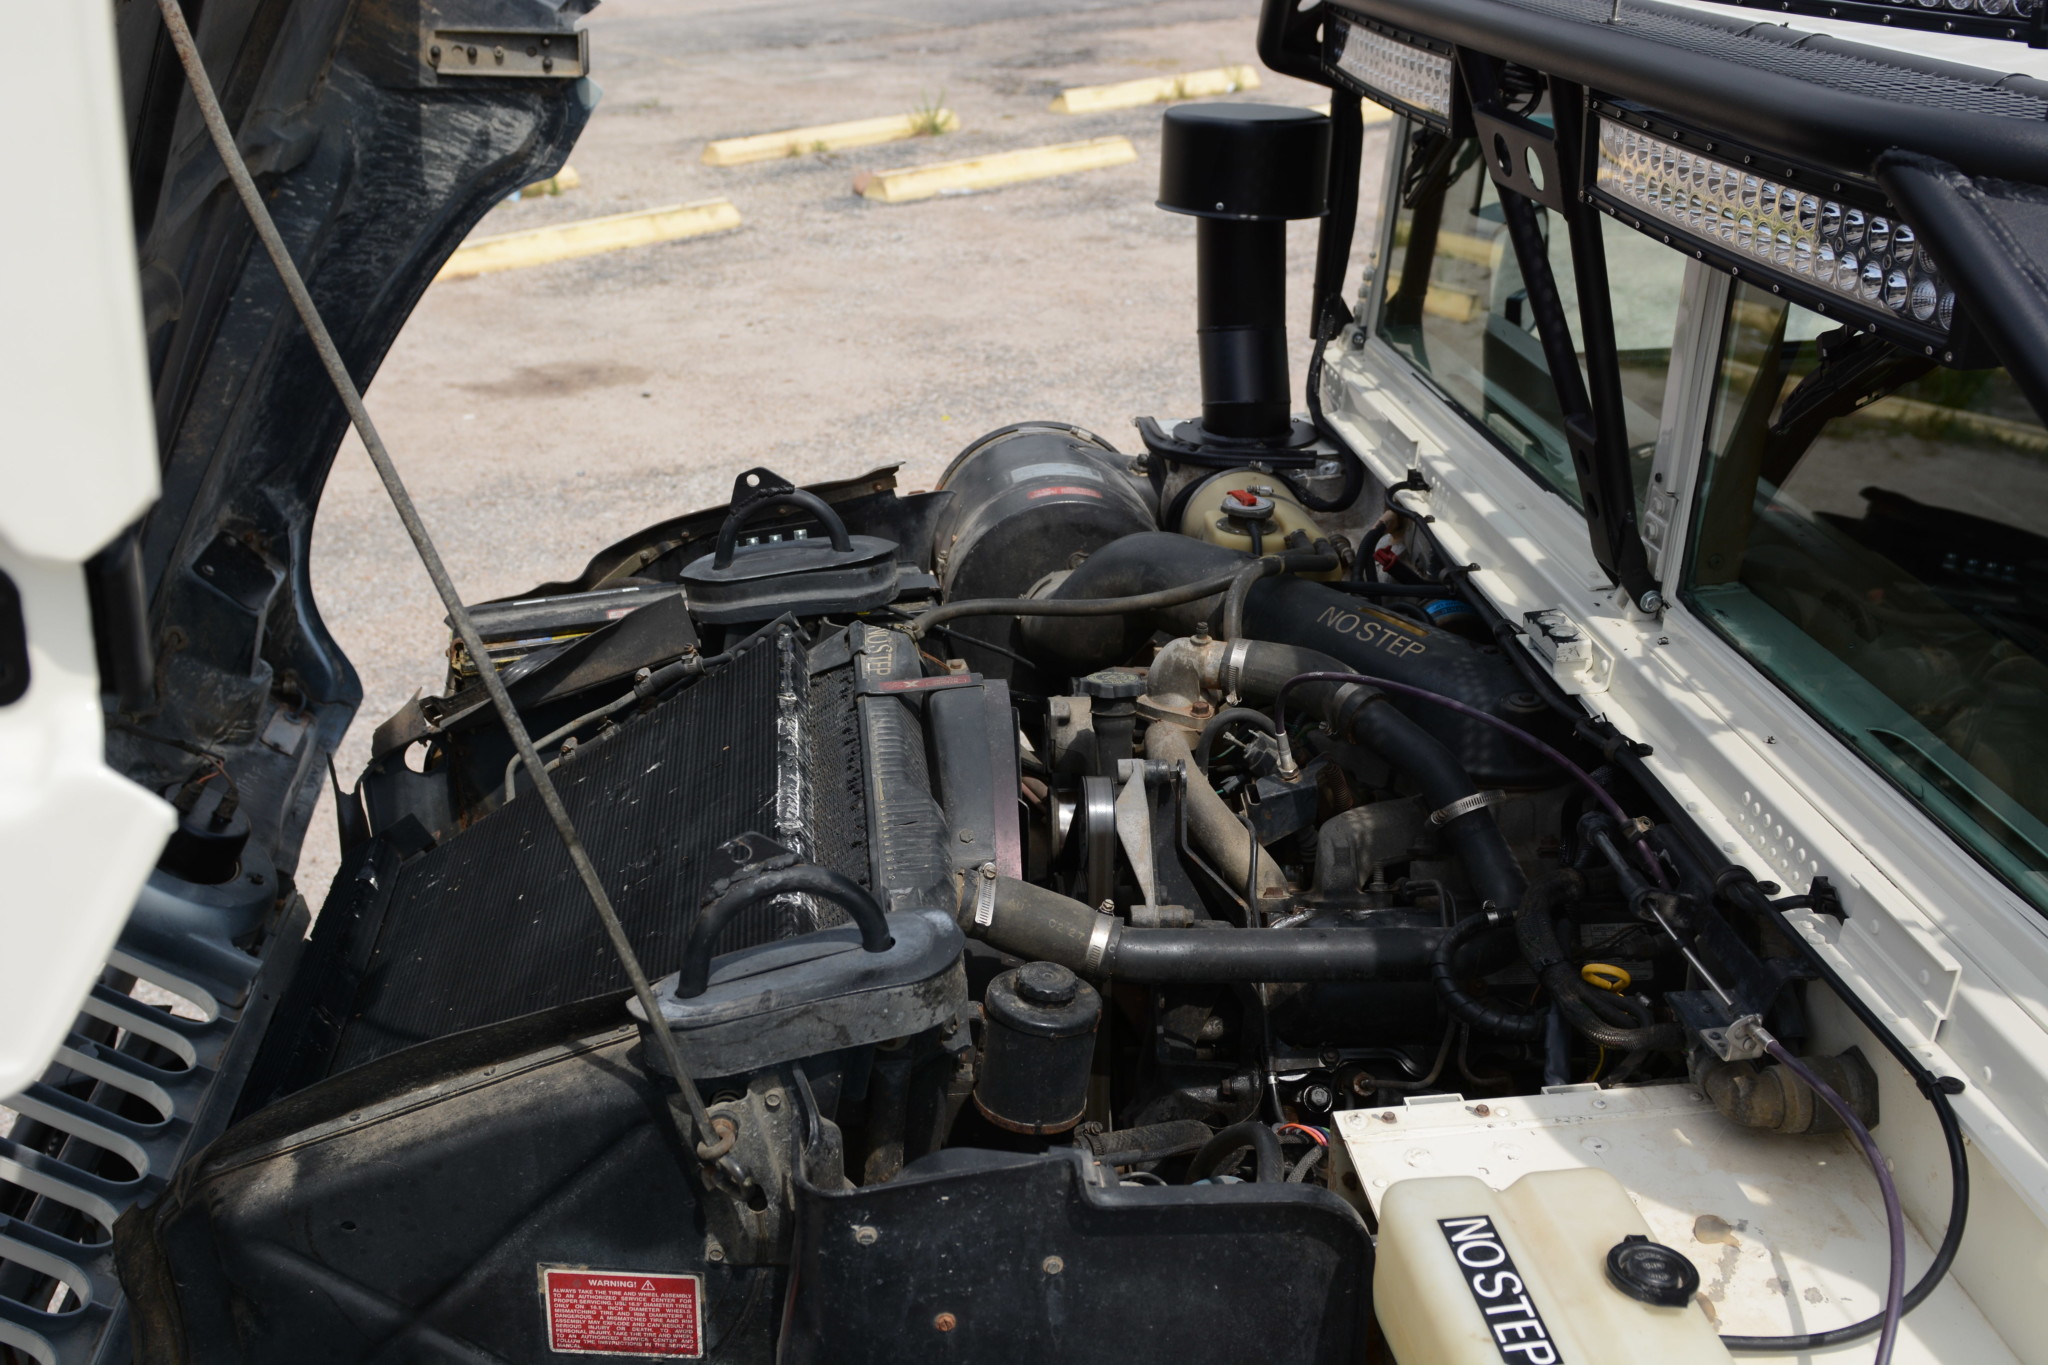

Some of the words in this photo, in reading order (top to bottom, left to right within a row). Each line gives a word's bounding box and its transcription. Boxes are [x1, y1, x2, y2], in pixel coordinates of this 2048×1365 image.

[1316, 605, 1361, 634] NO
[1355, 621, 1426, 658] STEP
[867, 643, 893, 676] STEP
[1443, 1217, 1506, 1269] NO
[588, 1279, 637, 1288] WARNING!
[1472, 1270, 1556, 1365] STEP
